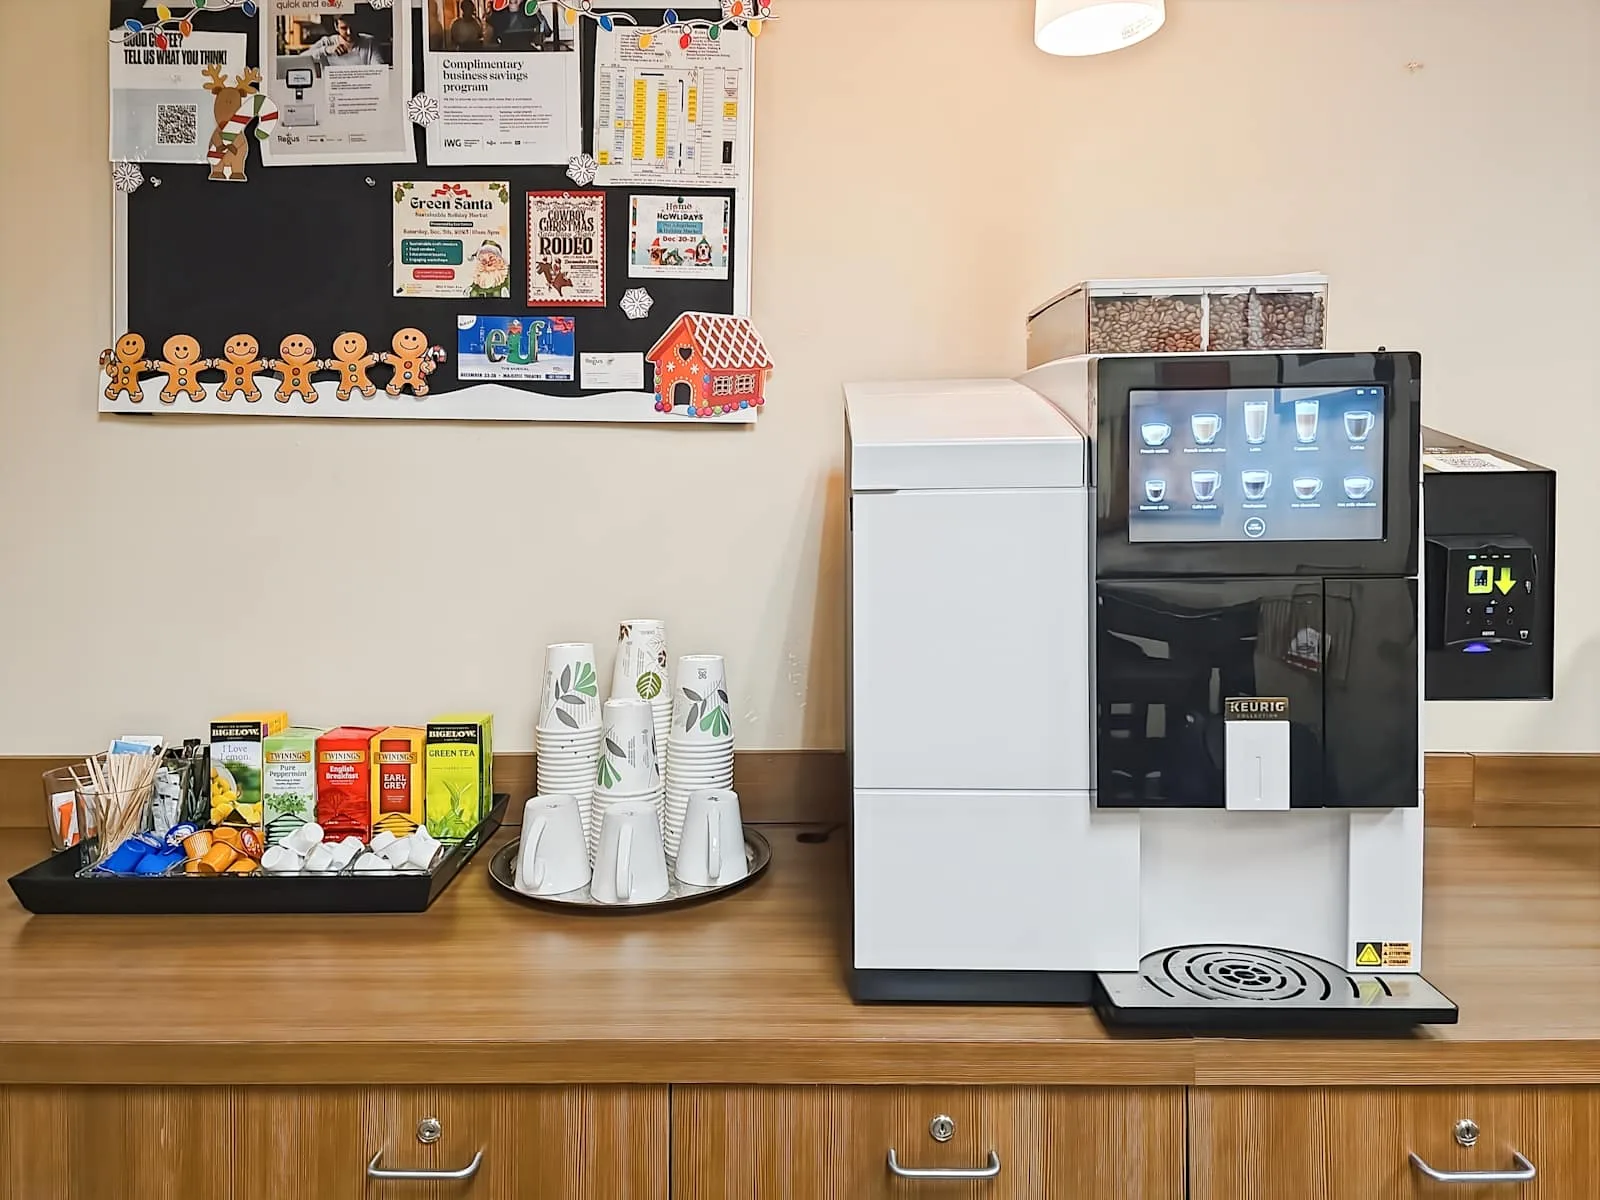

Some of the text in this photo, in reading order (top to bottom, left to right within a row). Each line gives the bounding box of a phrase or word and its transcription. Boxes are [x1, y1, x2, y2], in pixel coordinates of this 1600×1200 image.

[276, 0, 344, 10] quick and ey.
[124, 49, 227, 65] TELL US WHAT YOU THINK!
[442, 58, 524, 71] Complimentary
[442, 70, 528, 82] business savings
[443, 83, 489, 93] program
[444, 138, 462, 148] IWG
[410, 197, 493, 210] Green Santa
[548, 210, 586, 221] COWBOY
[657, 213, 703, 221] HOWLIDAYS
[539, 217, 594, 232] CHRISTMAS
[540, 237, 593, 255] RODEO
[1229, 702, 1285, 712] KEURIG
[228, 744, 248, 752] Love
[428, 749, 476, 758] GREEN TEA
[269, 770, 307, 778] Peppermint
[329, 765, 355, 773] English
[325, 772, 359, 780] Breakfast
[383, 773, 407, 781] EARL
[383, 781, 407, 790] GREY
